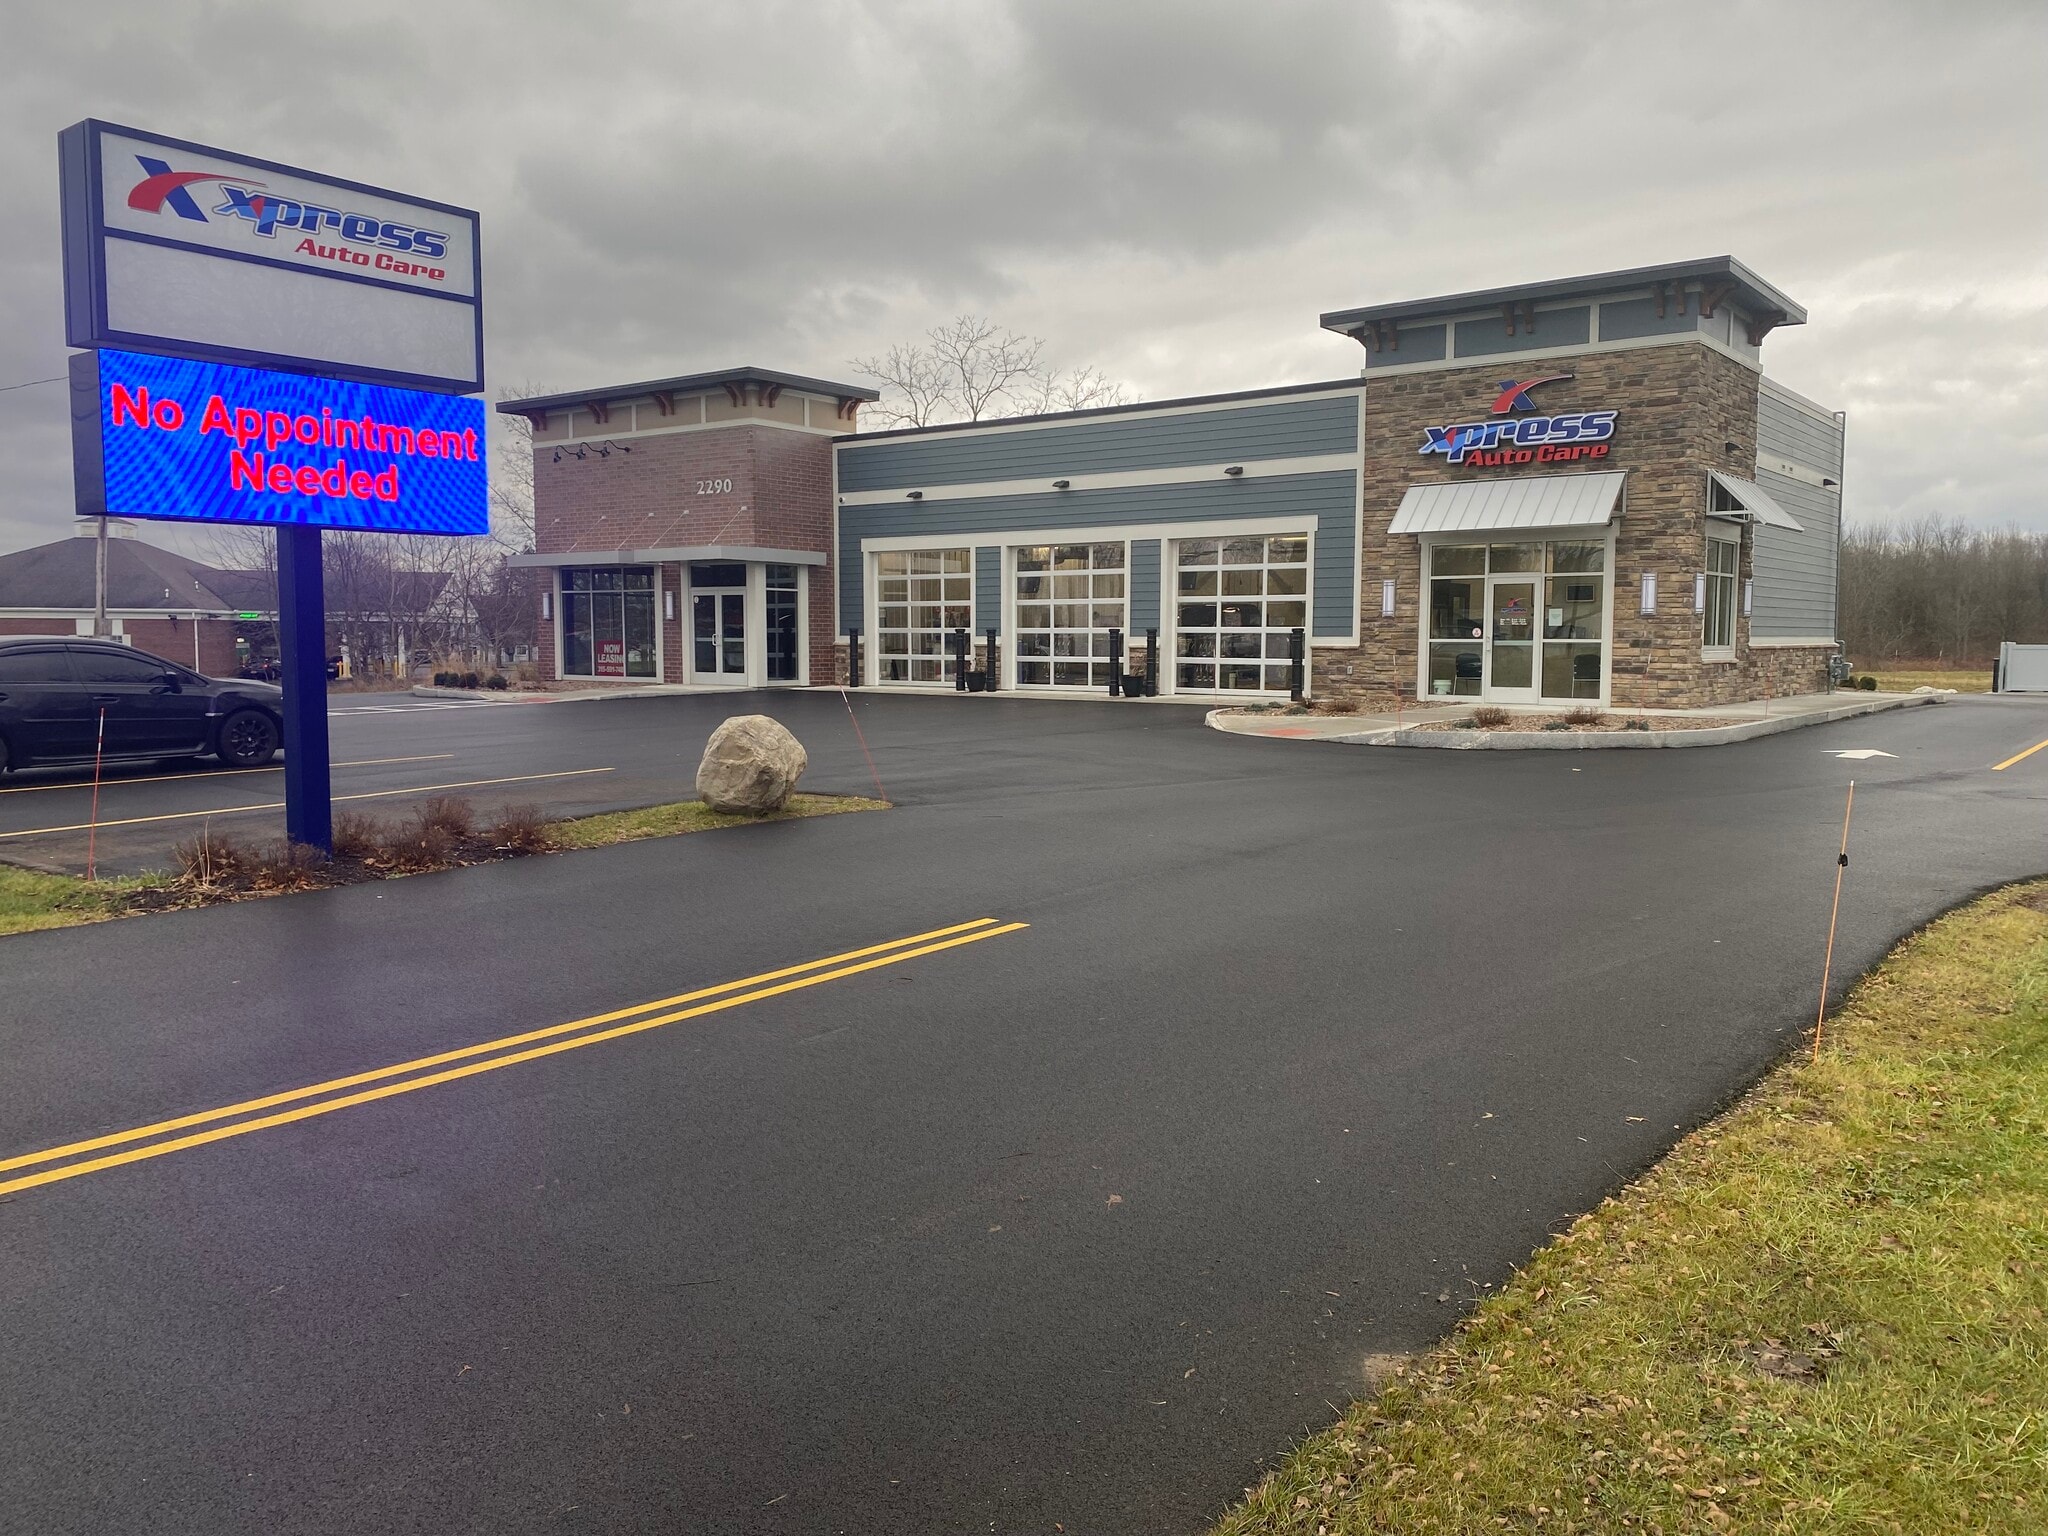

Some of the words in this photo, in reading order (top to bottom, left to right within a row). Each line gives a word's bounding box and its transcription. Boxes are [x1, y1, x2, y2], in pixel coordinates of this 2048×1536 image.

[295, 238, 370, 267] Auto
[375, 253, 445, 281] Care
[111, 383, 184, 431] No
[200, 395, 478, 461] Appointment
[1465, 449, 1532, 467] Auto
[1536, 444, 1609, 463] Care
[230, 450, 399, 502] Needed
[696, 478, 733, 495] 2290
[603, 643, 621, 653] NOW
